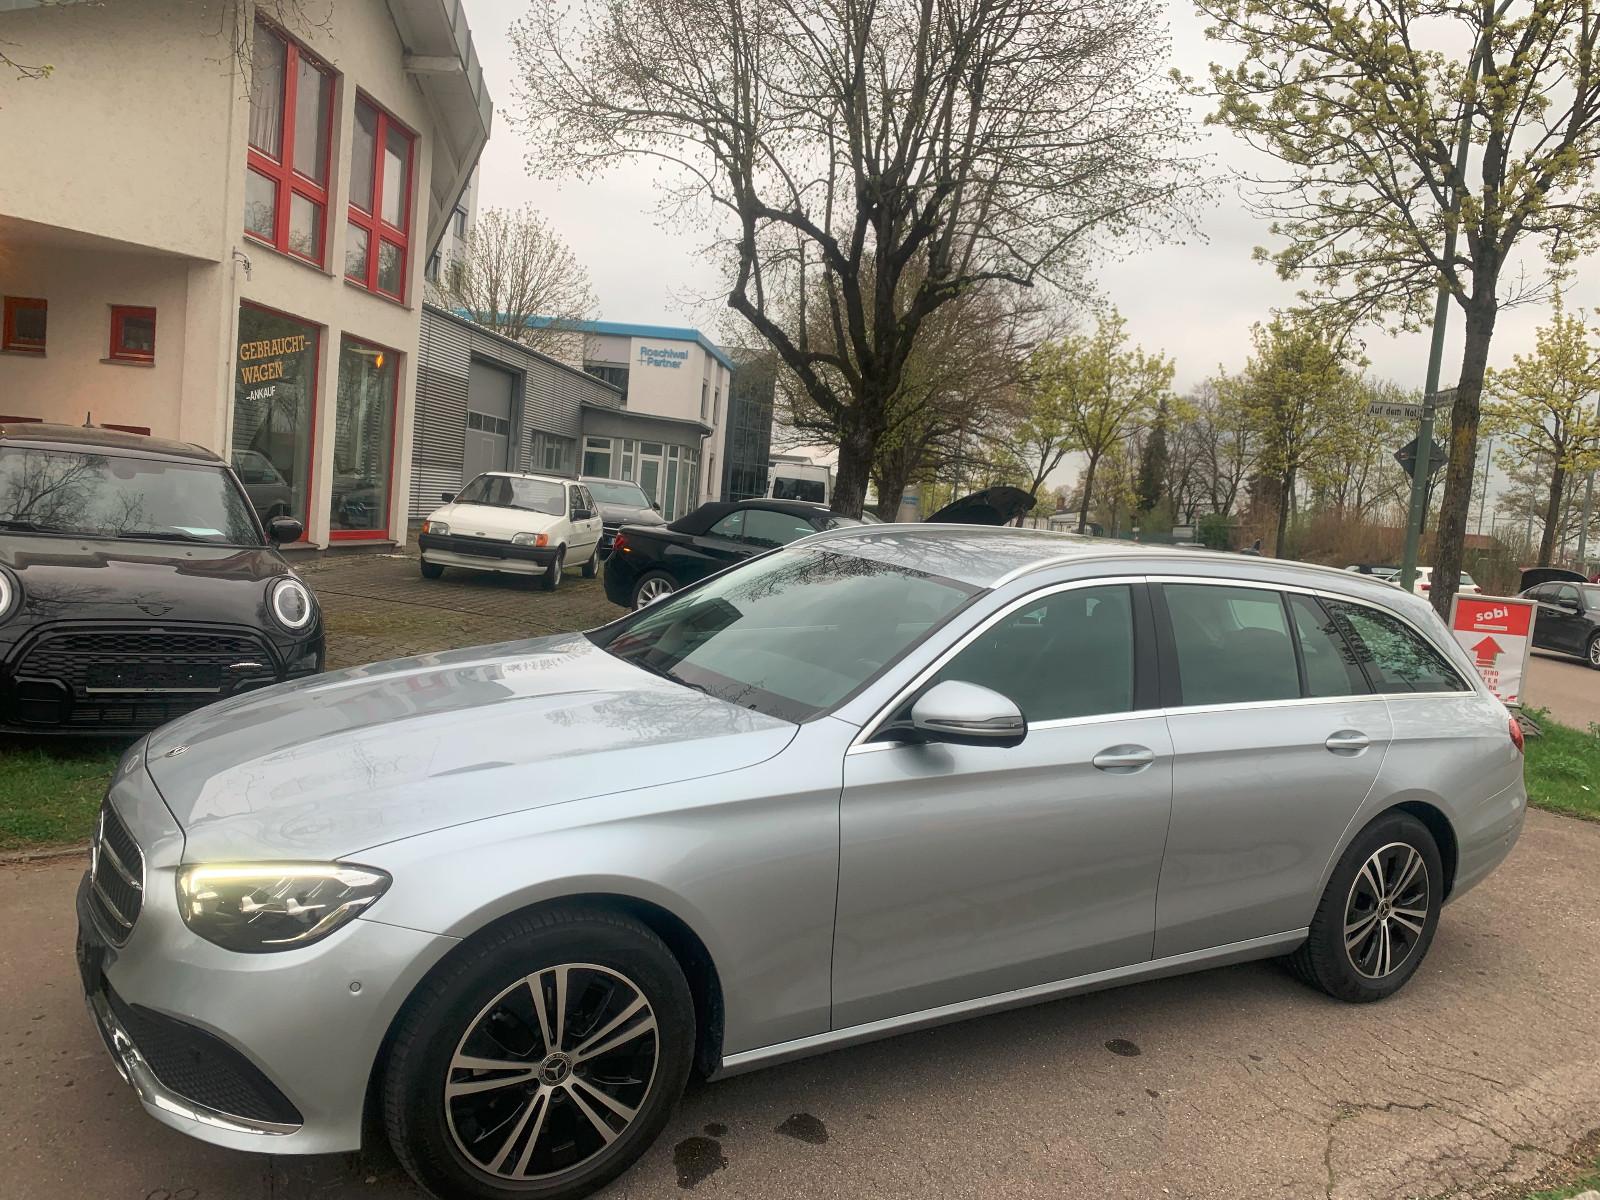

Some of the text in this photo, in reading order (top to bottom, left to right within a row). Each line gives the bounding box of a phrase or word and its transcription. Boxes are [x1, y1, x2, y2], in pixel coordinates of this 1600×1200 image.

[240, 335, 311, 361] GEBRAUCHT-
[241, 361, 283, 384] WAGEN
[1369, 405, 1383, 415] Auf
[1386, 406, 1401, 417] dem
[1476, 606, 1509, 621] sobi
